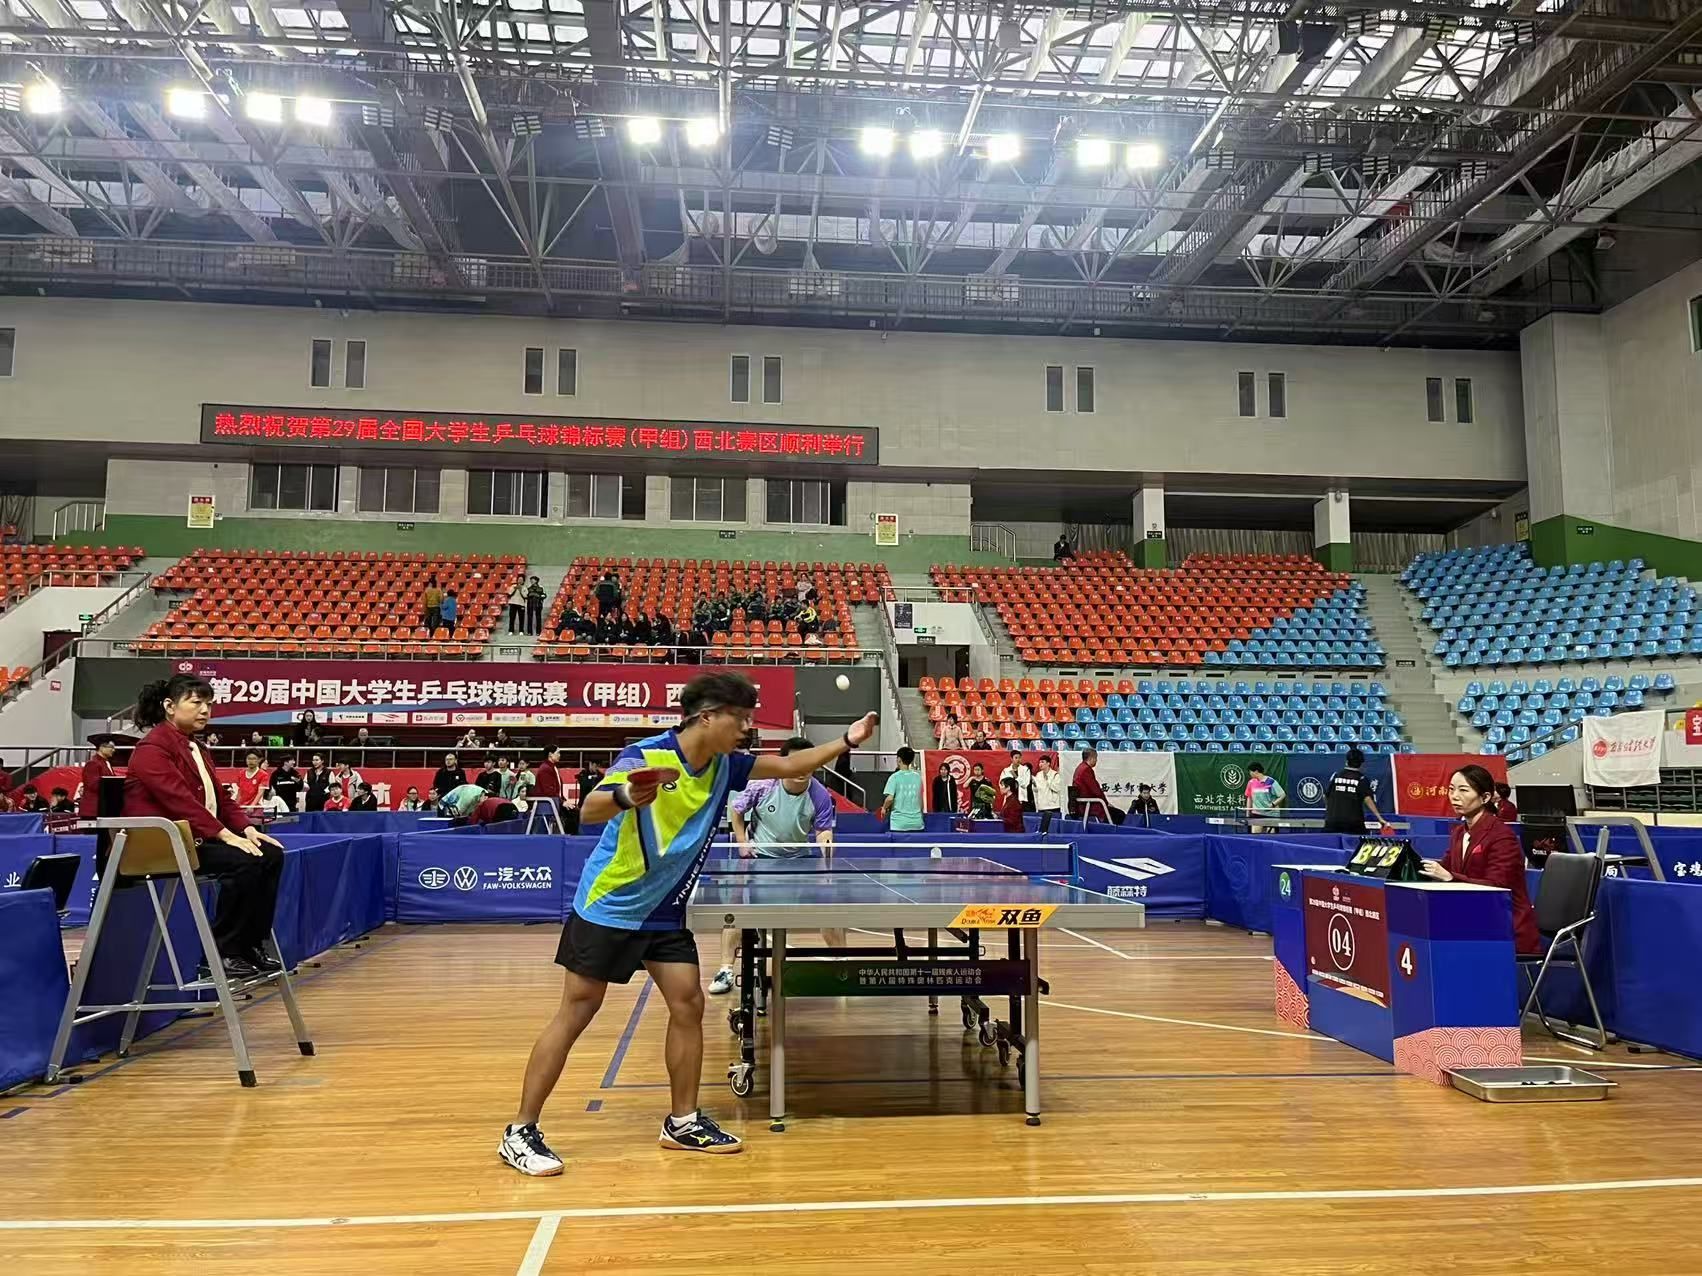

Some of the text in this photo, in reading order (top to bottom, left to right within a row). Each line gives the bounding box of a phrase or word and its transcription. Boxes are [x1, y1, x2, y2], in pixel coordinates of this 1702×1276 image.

[483, 882, 552, 890] FAW-VOLKSWAGEN
[1279, 881, 1292, 897] 24
[997, 908, 1042, 926] 双鱼
[1332, 928, 1352, 957] 04
[1401, 947, 1413, 976] 4
